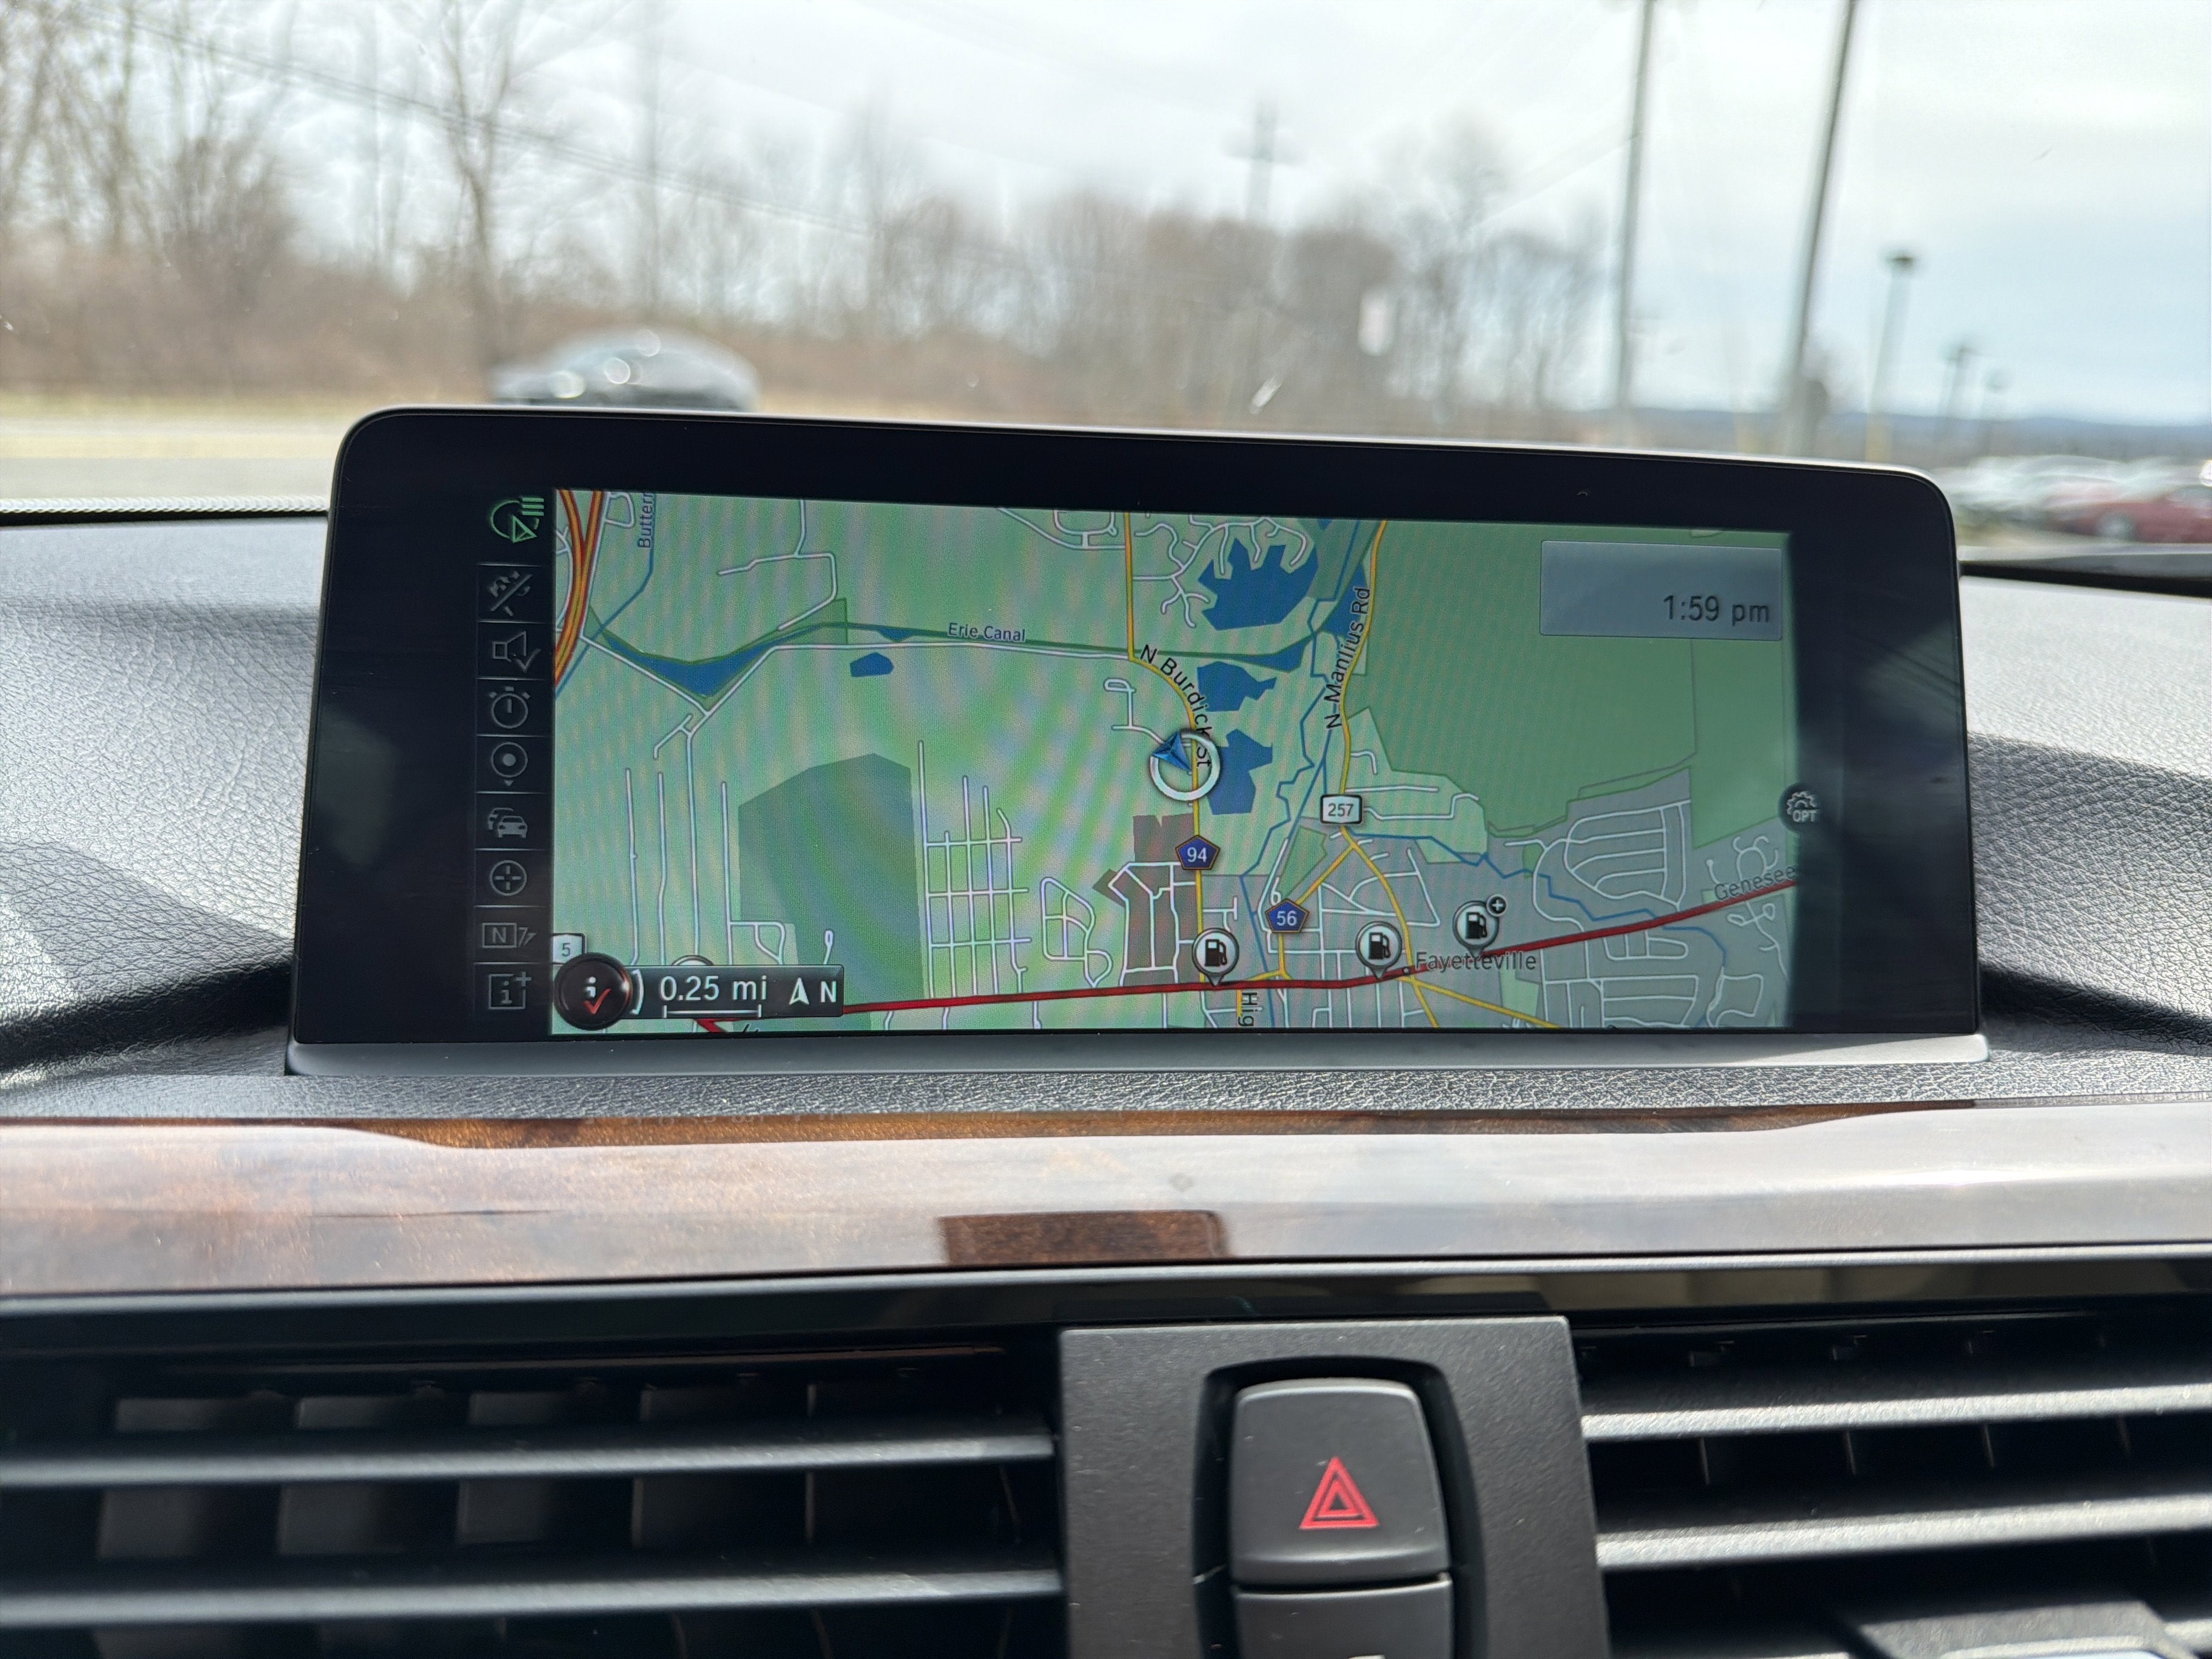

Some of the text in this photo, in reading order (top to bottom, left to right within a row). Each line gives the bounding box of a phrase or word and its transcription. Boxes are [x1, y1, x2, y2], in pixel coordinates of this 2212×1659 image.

[1663, 595, 1770, 627] 1:59 pm
[948, 622, 1026, 642] Erie Canal
[1324, 588, 1370, 729] N Manlius Rd
[1140, 644, 1212, 768] N Burdick St
[1328, 803, 1354, 817] 257
[1792, 809, 1818, 822] OPT
[1186, 847, 1207, 863] 94
[1714, 866, 1797, 900] Genesee
[1276, 910, 1297, 926] 56
[562, 943, 571, 957] 5
[1415, 951, 1537, 973] Fayetteville
[660, 975, 837, 1003] 0.25 mi N
[1238, 992, 1259, 1026] Hig
